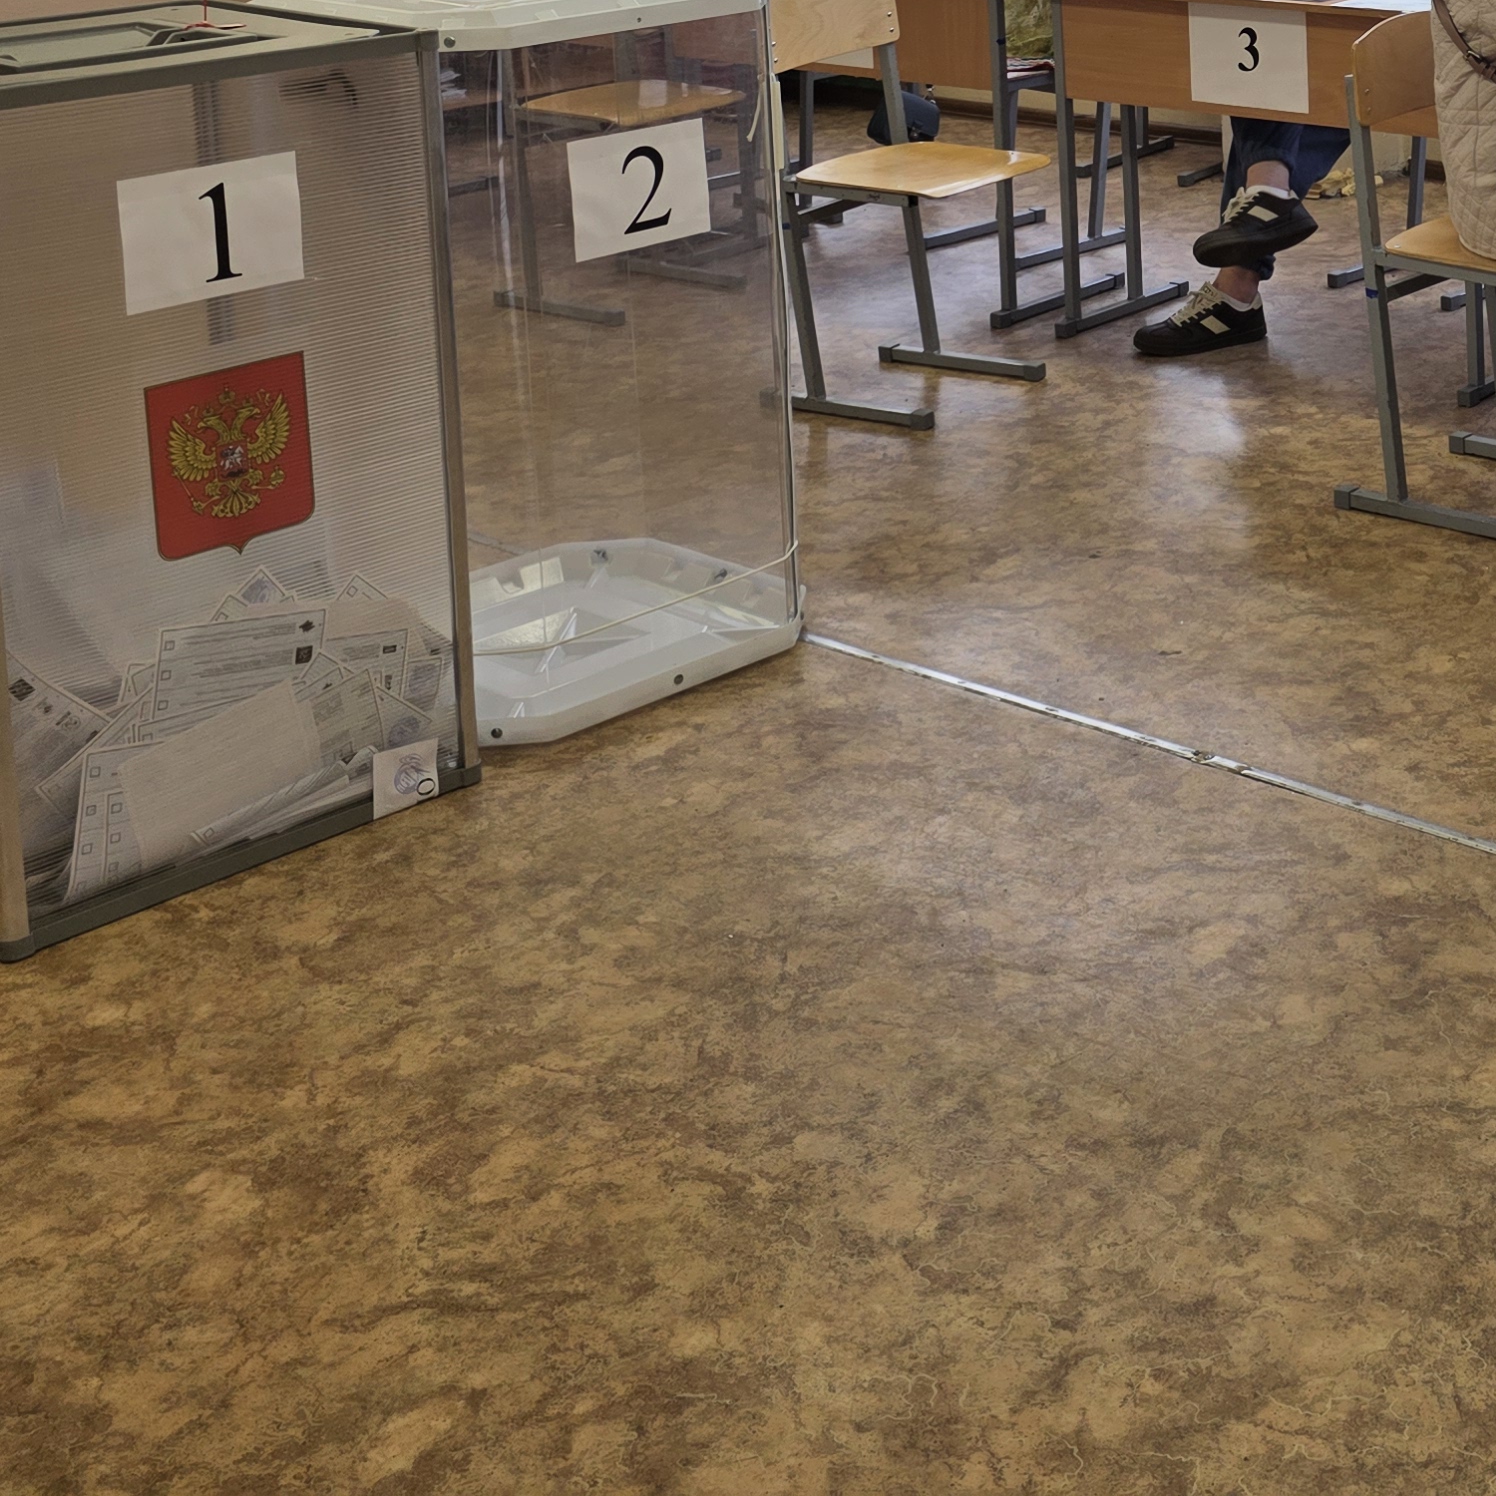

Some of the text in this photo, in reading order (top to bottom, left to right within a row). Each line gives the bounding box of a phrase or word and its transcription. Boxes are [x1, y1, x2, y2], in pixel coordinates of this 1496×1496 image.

[1237, 26, 1260, 72] 3
[198, 182, 243, 283] 1
[621, 145, 672, 235] 2
